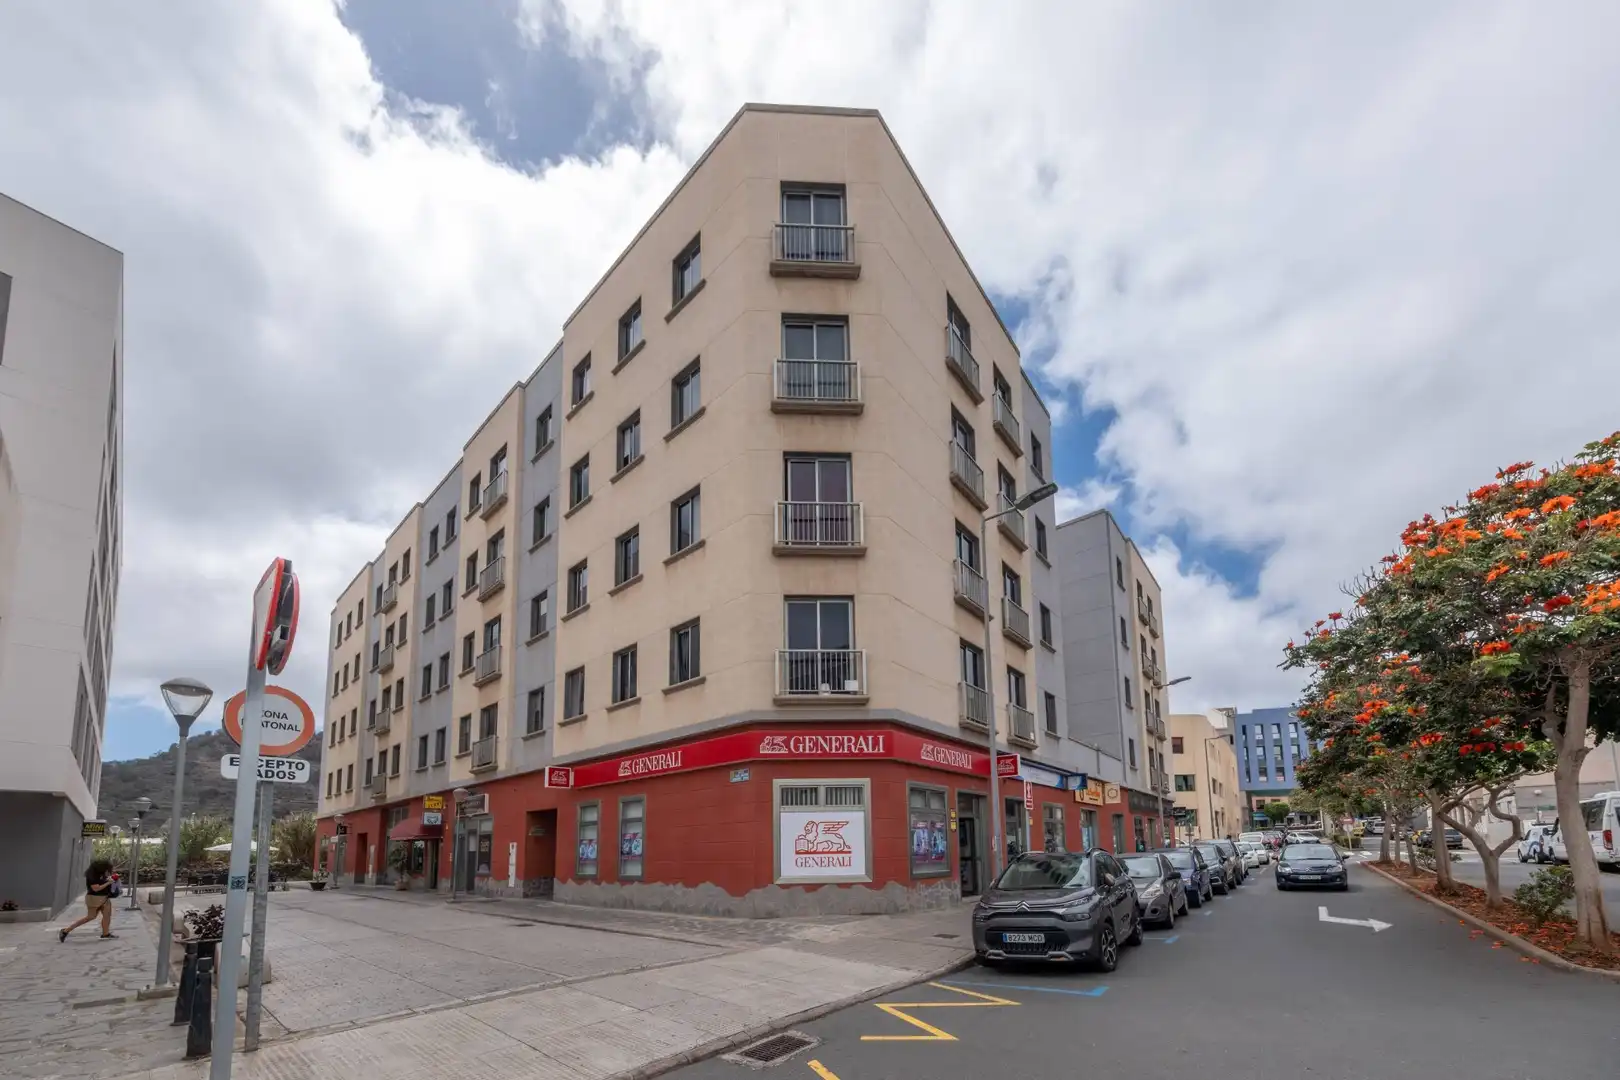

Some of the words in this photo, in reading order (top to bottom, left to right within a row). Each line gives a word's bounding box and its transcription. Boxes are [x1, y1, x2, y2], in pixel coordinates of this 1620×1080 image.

[241, 718, 301, 732] TONAL
[789, 735, 885, 754] GENERALI
[229, 757, 305, 771] ECEPTO
[632, 751, 683, 775] GENERALI
[933, 748, 972, 770] GENERALI
[256, 769, 297, 780] ADOS
[795, 856, 852, 868] GENERALI
